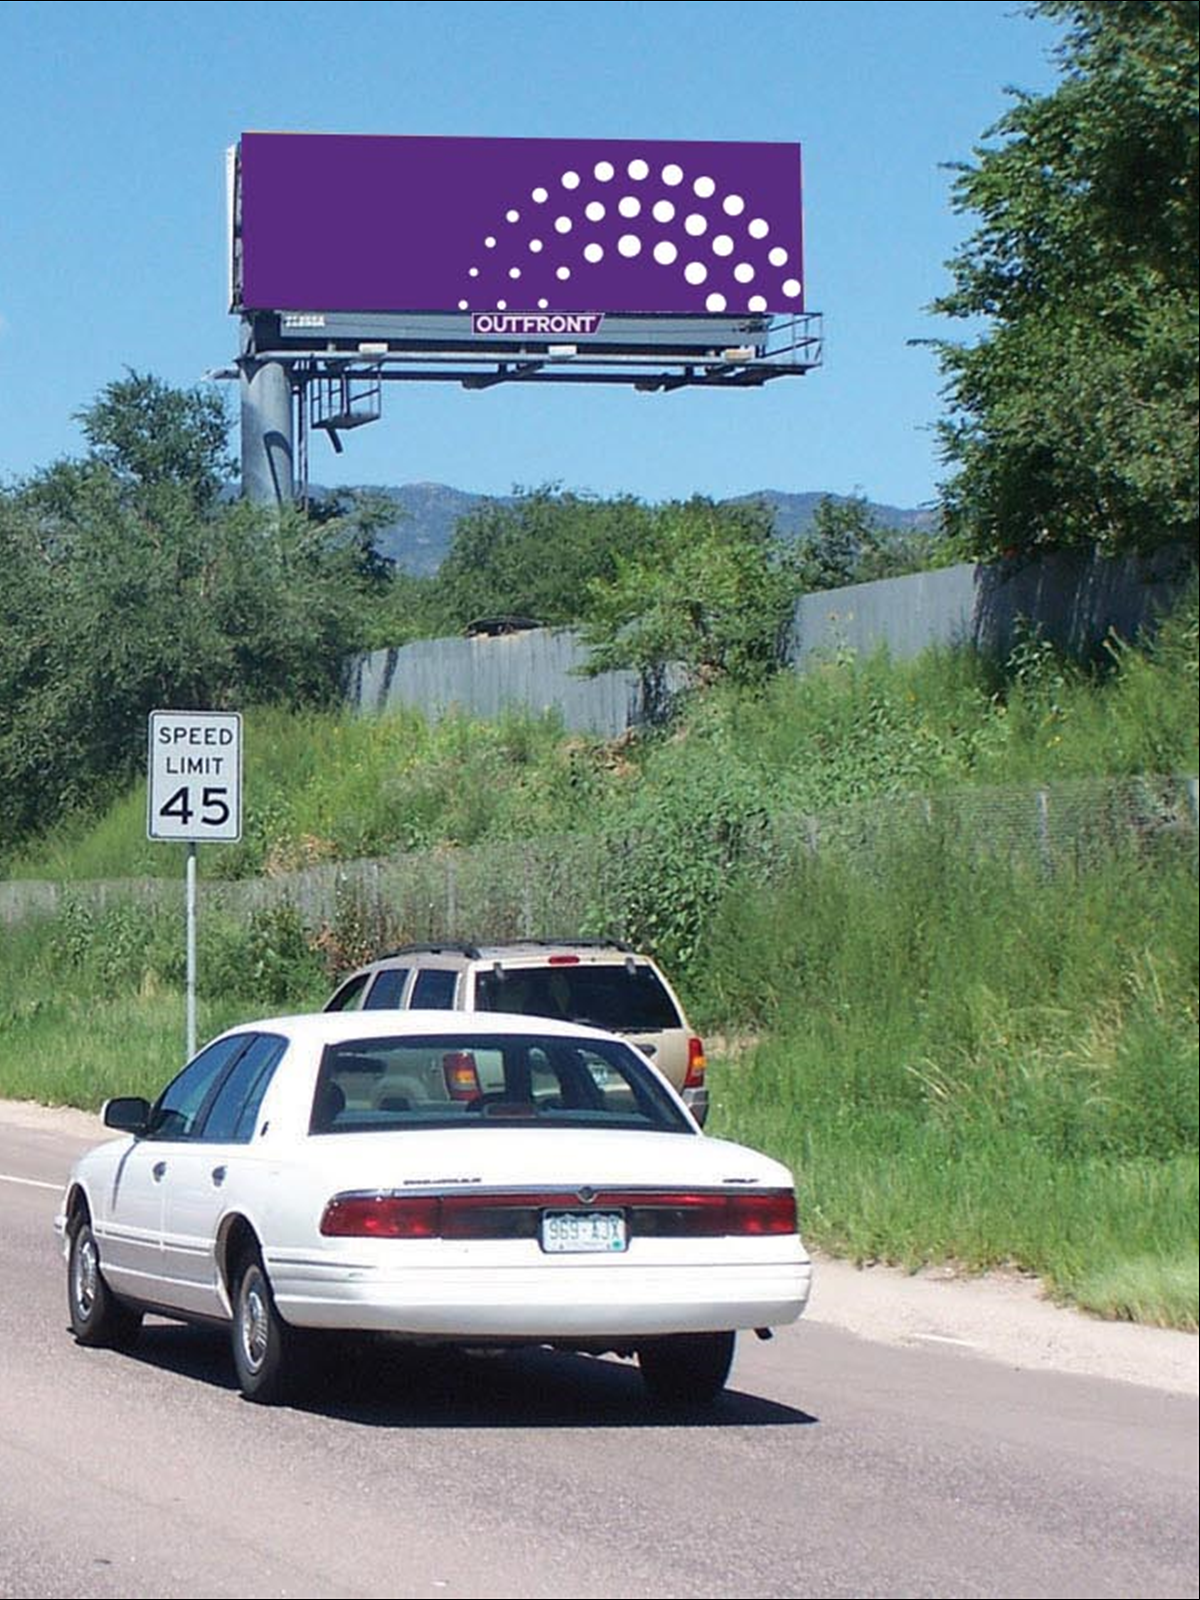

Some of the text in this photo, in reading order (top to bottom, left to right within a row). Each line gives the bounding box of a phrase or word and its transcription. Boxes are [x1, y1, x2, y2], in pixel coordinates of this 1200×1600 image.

[476, 315, 597, 333] OUTFRONT
[158, 727, 234, 746] SPEED
[166, 756, 224, 775] LIMIT
[159, 785, 231, 827] 45
